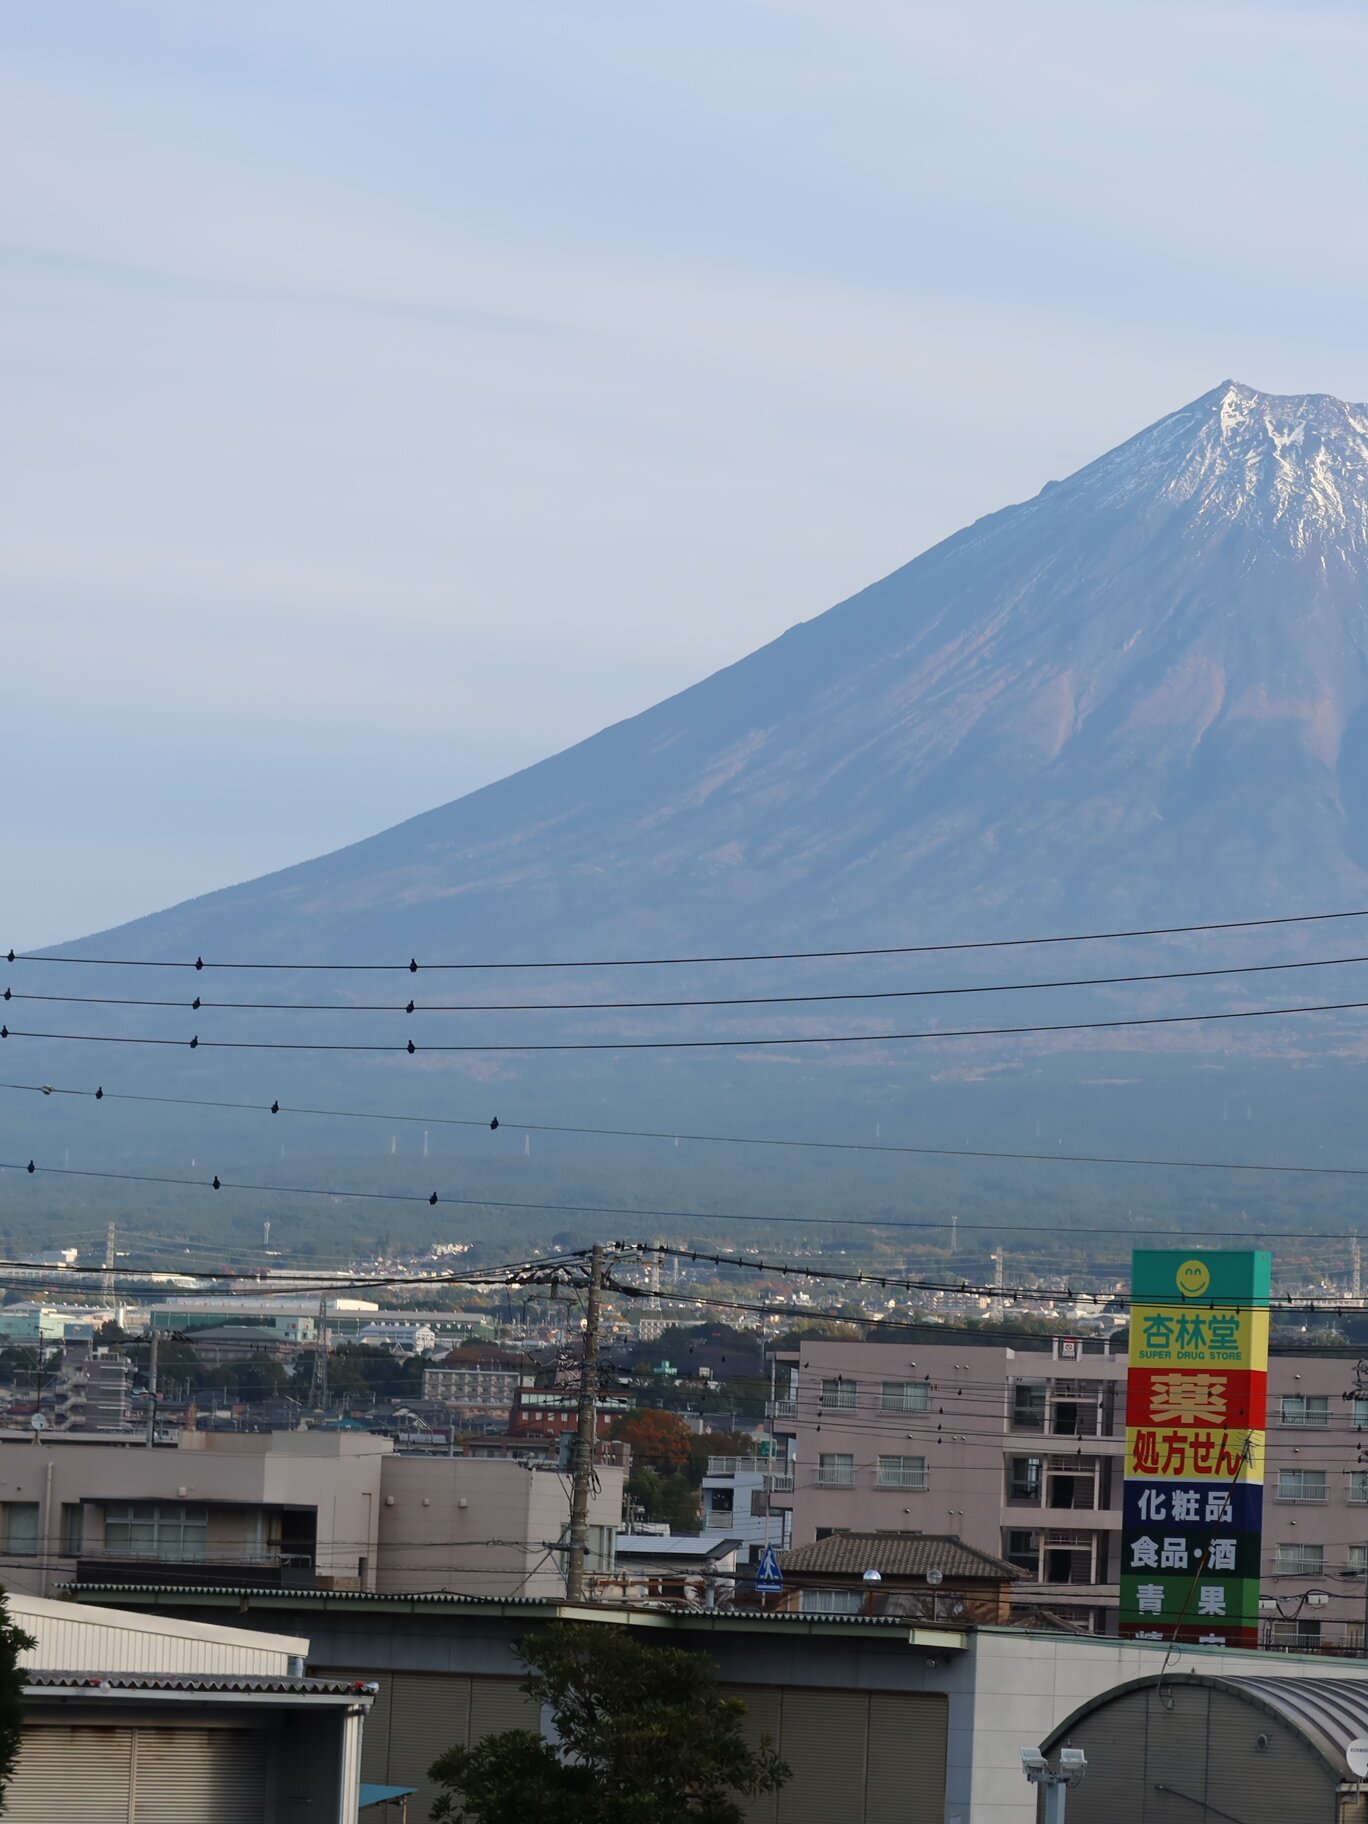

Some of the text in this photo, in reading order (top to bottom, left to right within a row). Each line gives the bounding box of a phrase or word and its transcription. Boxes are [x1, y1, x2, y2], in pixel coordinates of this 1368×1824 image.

[1143, 1313, 1240, 1350] 杏林堂
[1138, 1350, 1243, 1361] SUPER DRUG STORE
[1149, 1373, 1228, 1424] 薬
[1132, 1429, 1242, 1476] 処方せん
[1138, 1489, 1233, 1523] 化粧品
[1130, 1535, 1238, 1570] 食品・酒
[1136, 1583, 1227, 1616] 青果
